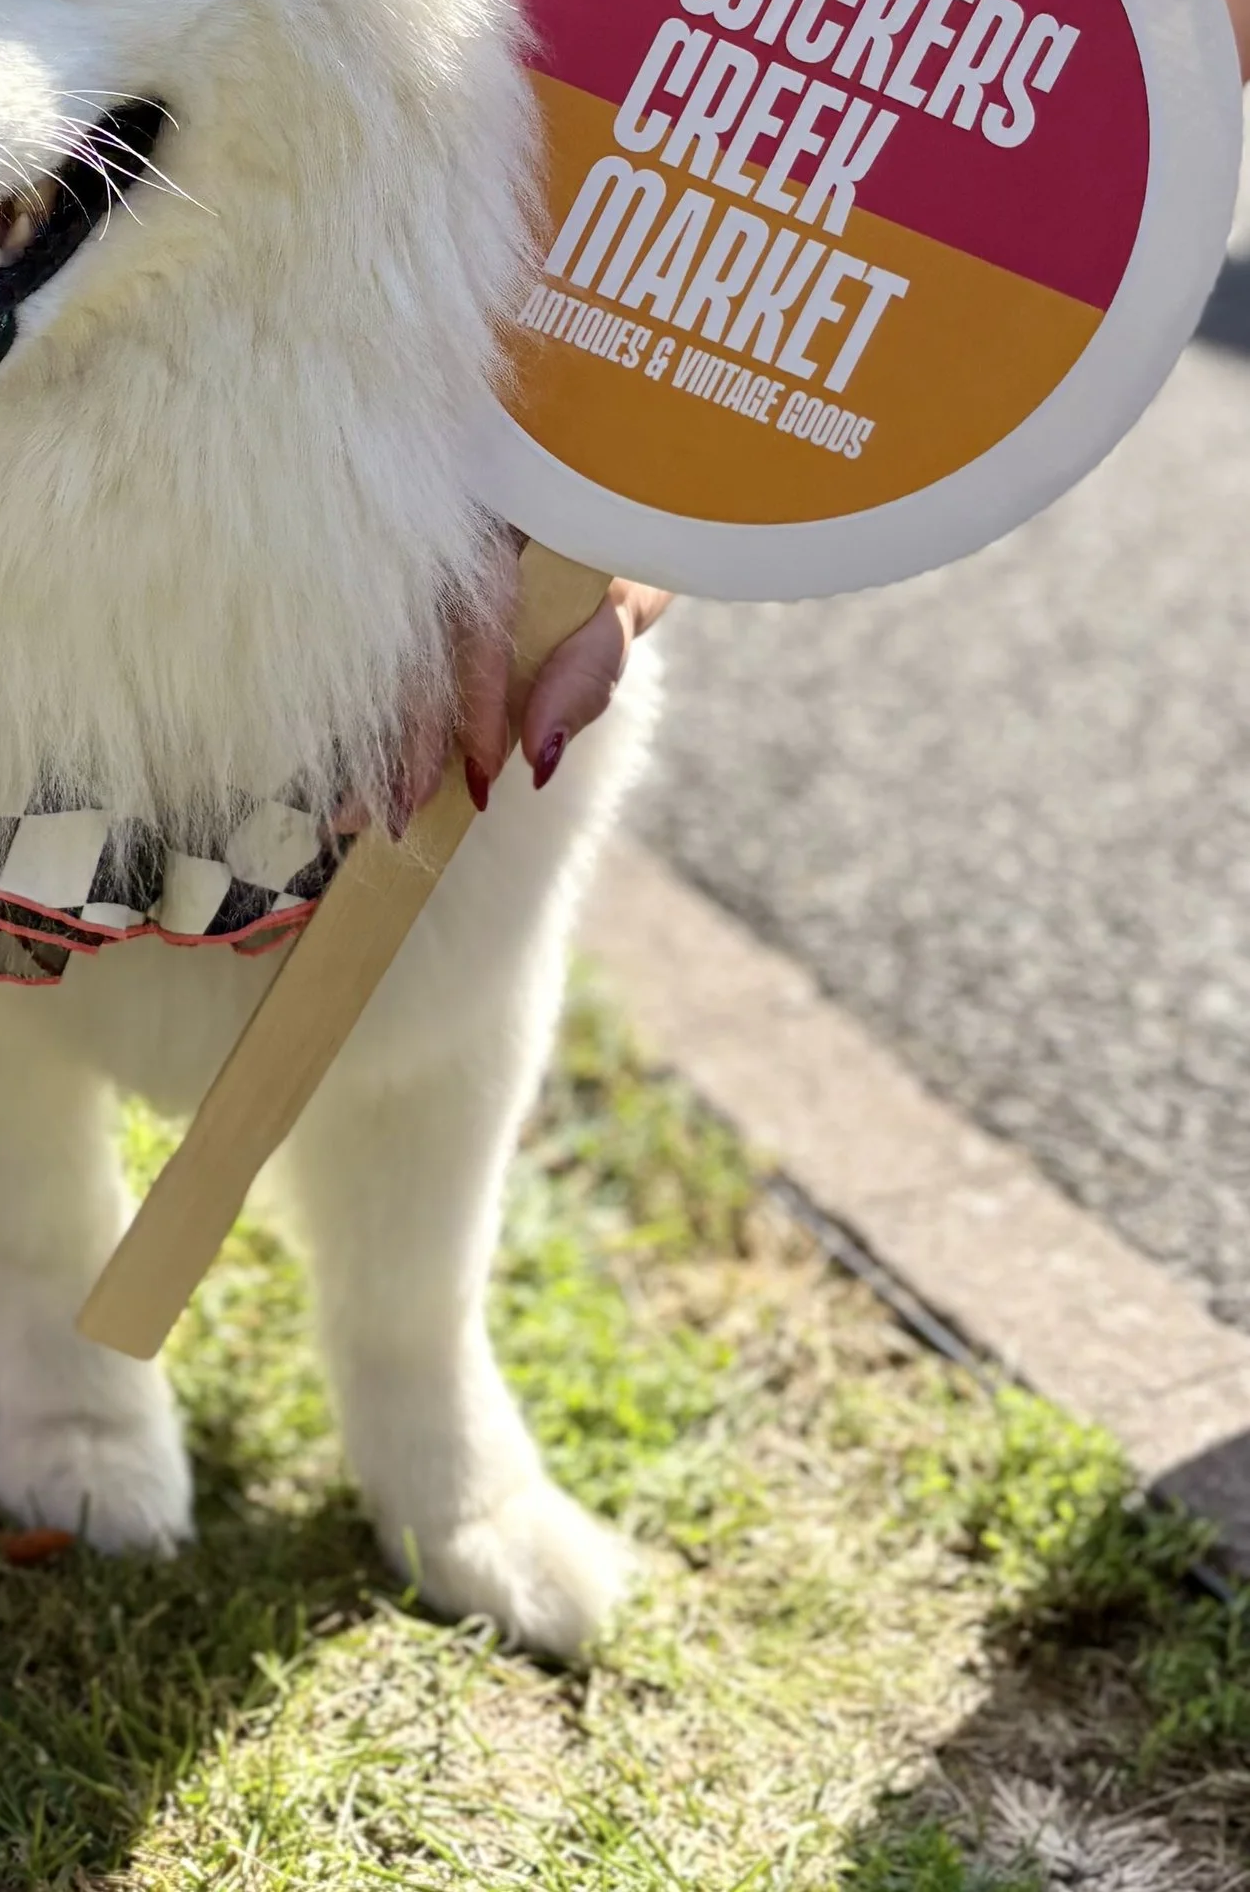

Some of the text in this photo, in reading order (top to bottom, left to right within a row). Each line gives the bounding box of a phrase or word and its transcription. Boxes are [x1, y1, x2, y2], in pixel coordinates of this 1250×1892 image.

[612, 17, 900, 237] CREEK
[517, 284, 876, 460] ANTIQUES & VINTAGE GOODS
[544, 155, 910, 394] MARKET
